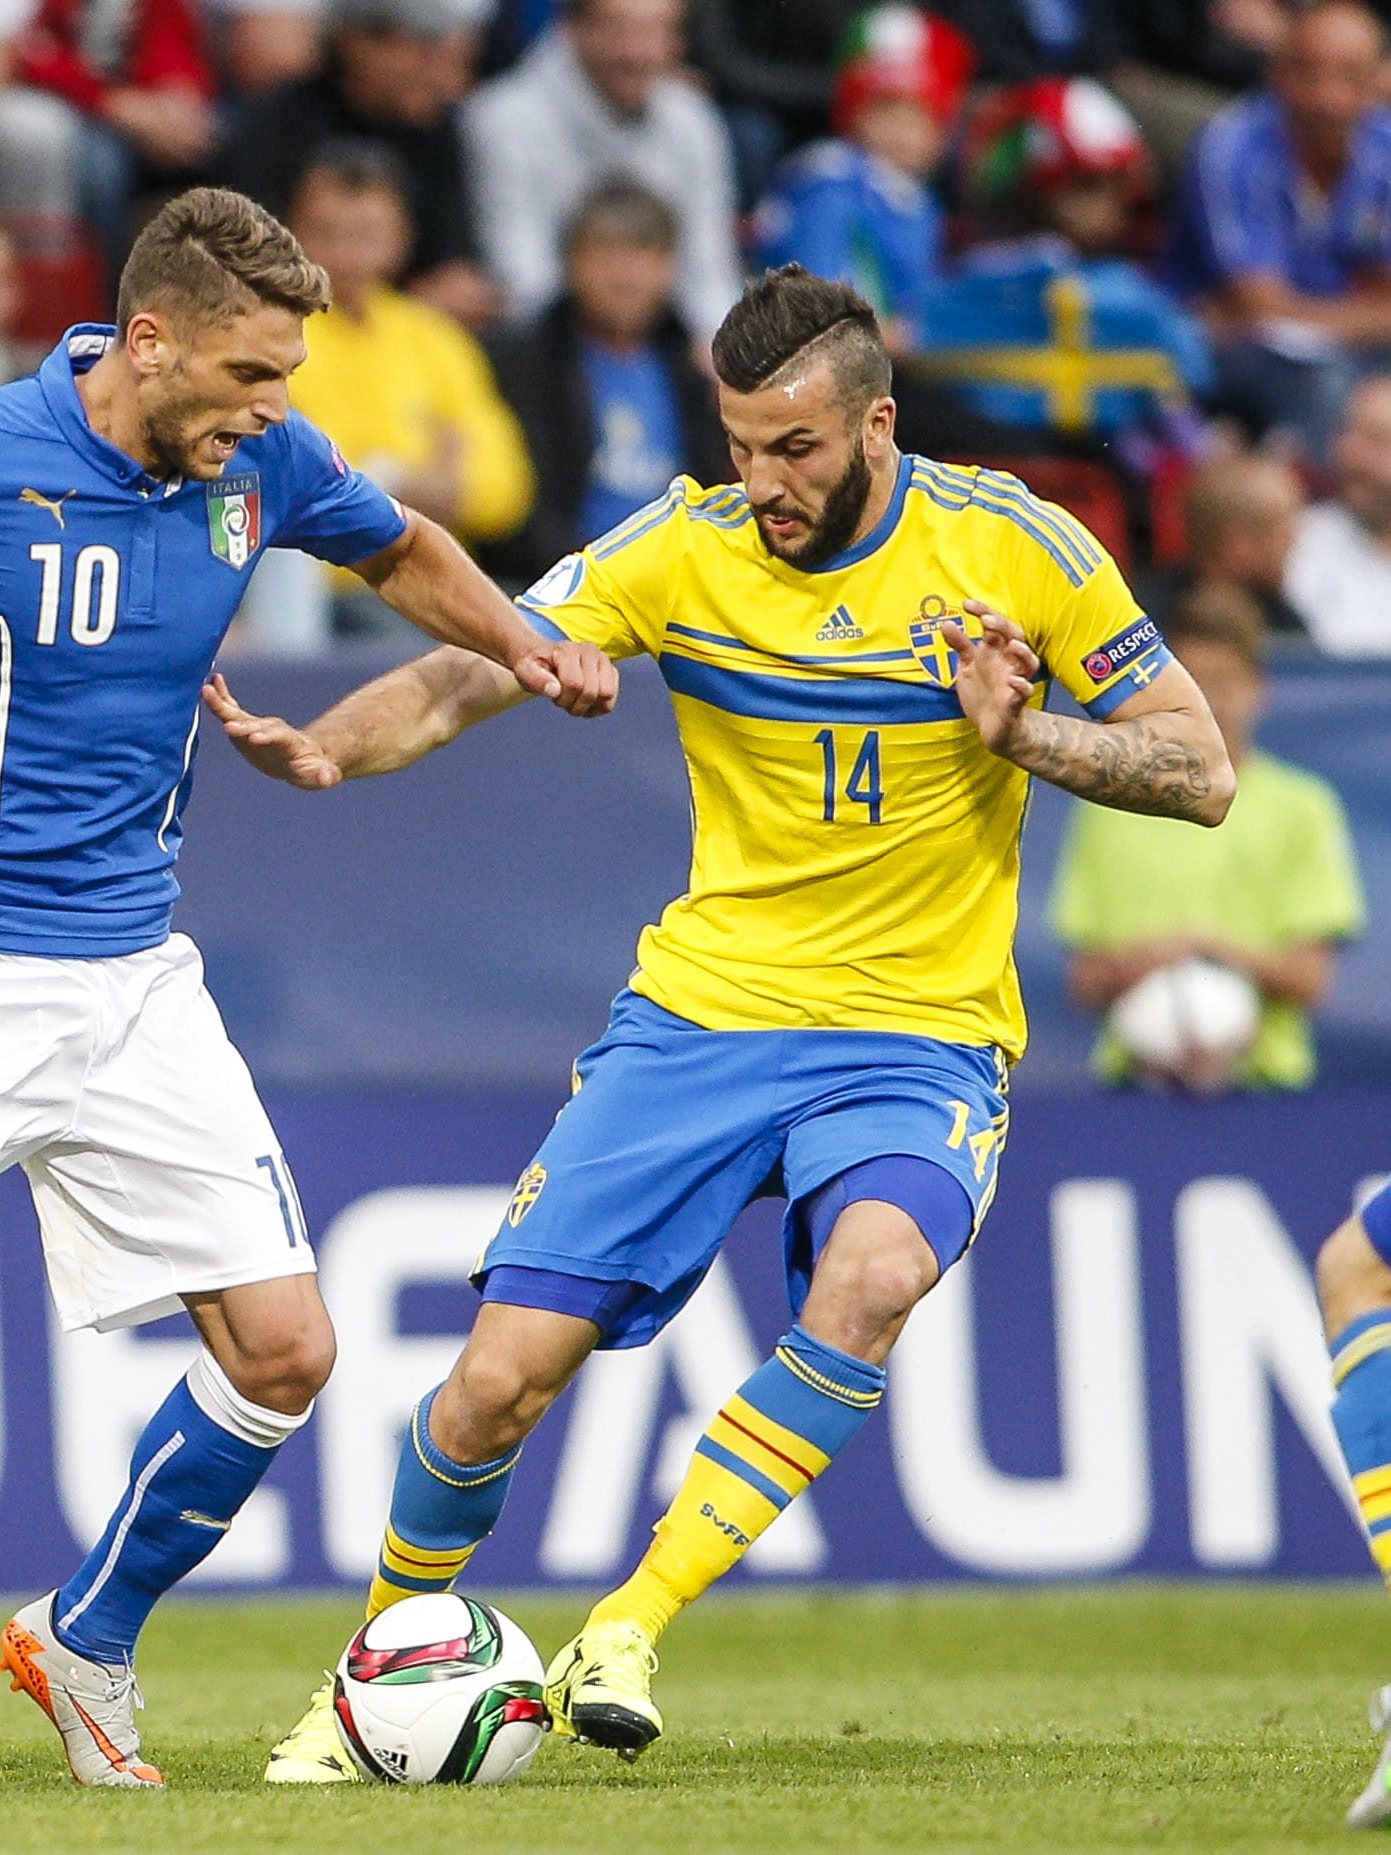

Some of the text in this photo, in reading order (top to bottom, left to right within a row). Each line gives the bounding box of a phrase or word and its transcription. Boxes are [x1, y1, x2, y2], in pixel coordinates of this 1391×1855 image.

[212, 479, 253, 495] ITALIA
[28, 542, 122, 647] 10
[815, 626, 865, 641] adidas
[1107, 621, 1159, 663] RESPECT
[813, 728, 885, 825] 14
[945, 1098, 996, 1184] 14
